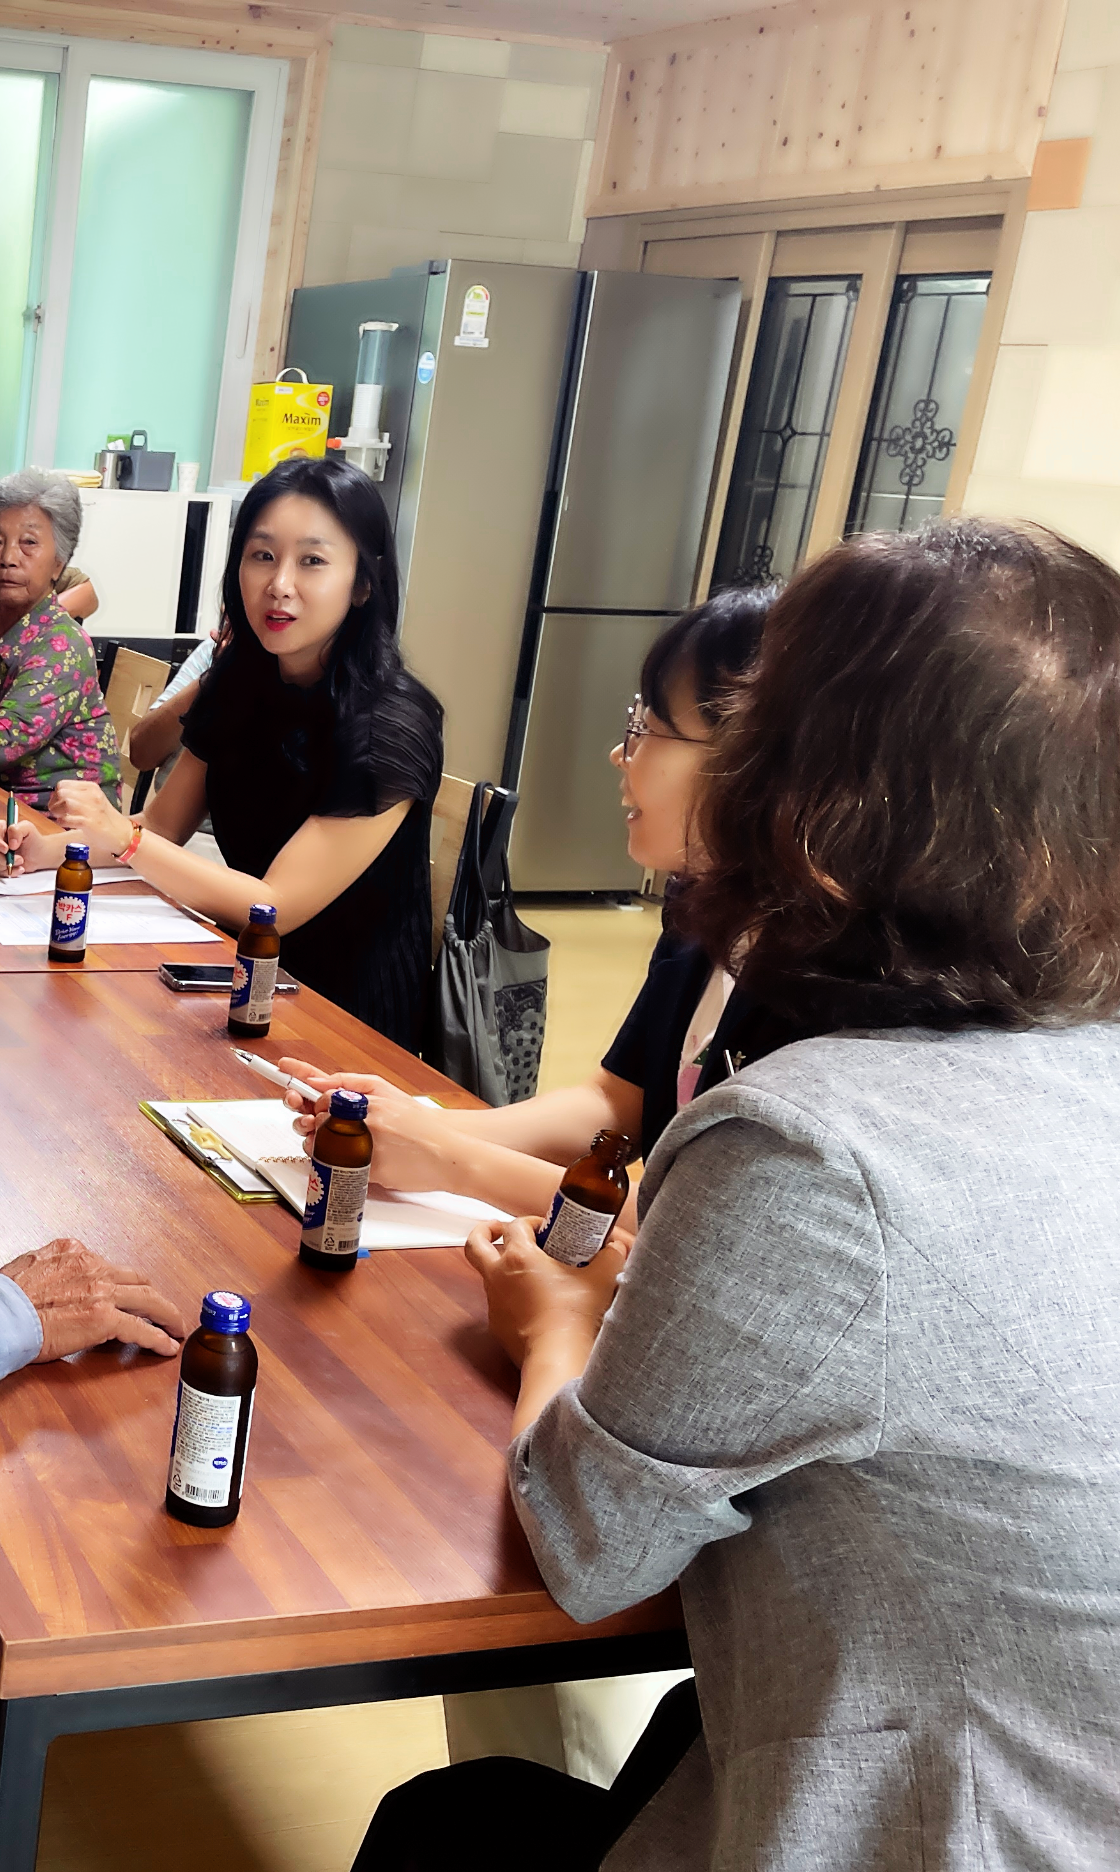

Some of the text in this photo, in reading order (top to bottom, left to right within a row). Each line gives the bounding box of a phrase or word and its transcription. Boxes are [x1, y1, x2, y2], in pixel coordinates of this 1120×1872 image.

[282, 412, 321, 426] Maxim
[57, 901, 83, 913] 박카스
[66, 913, 74, 921] F
